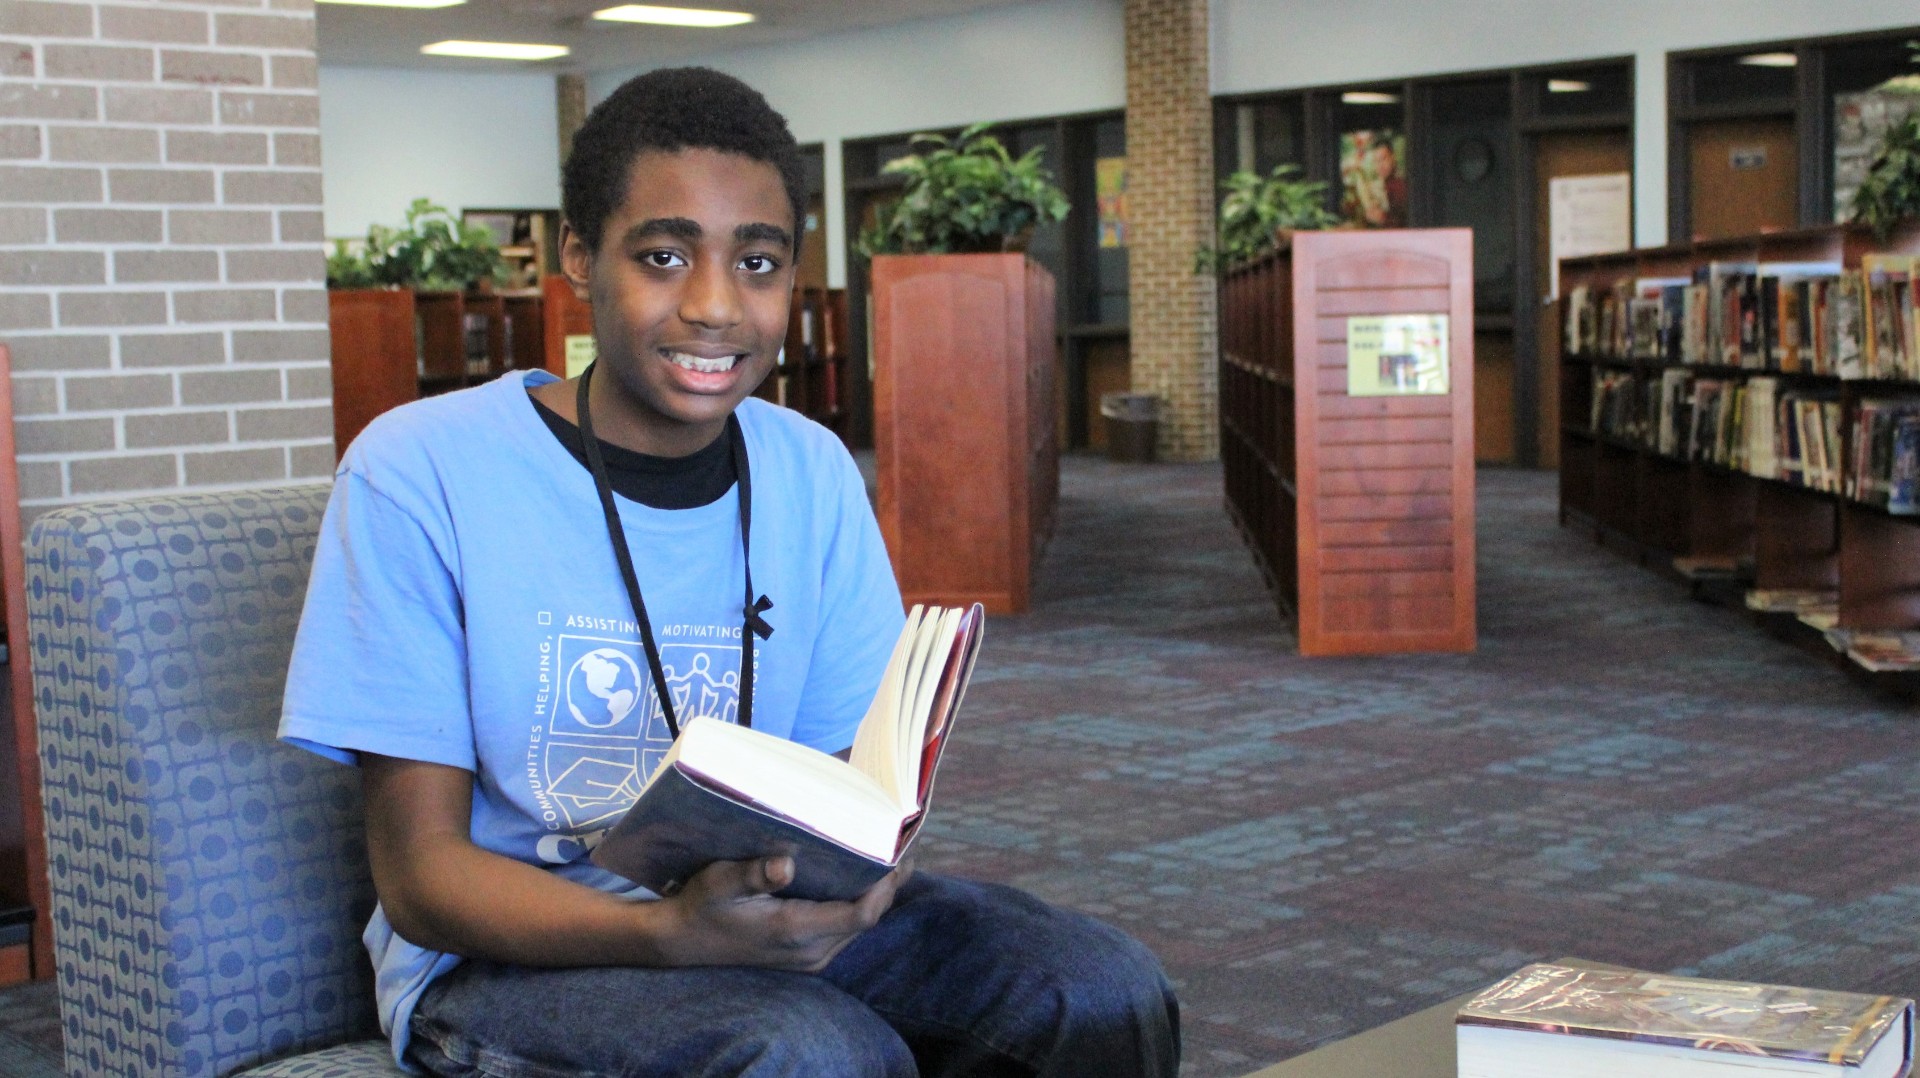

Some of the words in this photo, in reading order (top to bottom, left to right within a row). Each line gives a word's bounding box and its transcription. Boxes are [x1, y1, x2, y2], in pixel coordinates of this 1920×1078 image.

[566, 614, 641, 634] ASSISTIN
[661, 624, 742, 639] MOTIVATING
[534, 635, 553, 715] HELPING,
[527, 725, 561, 831] COMMUNITIES
